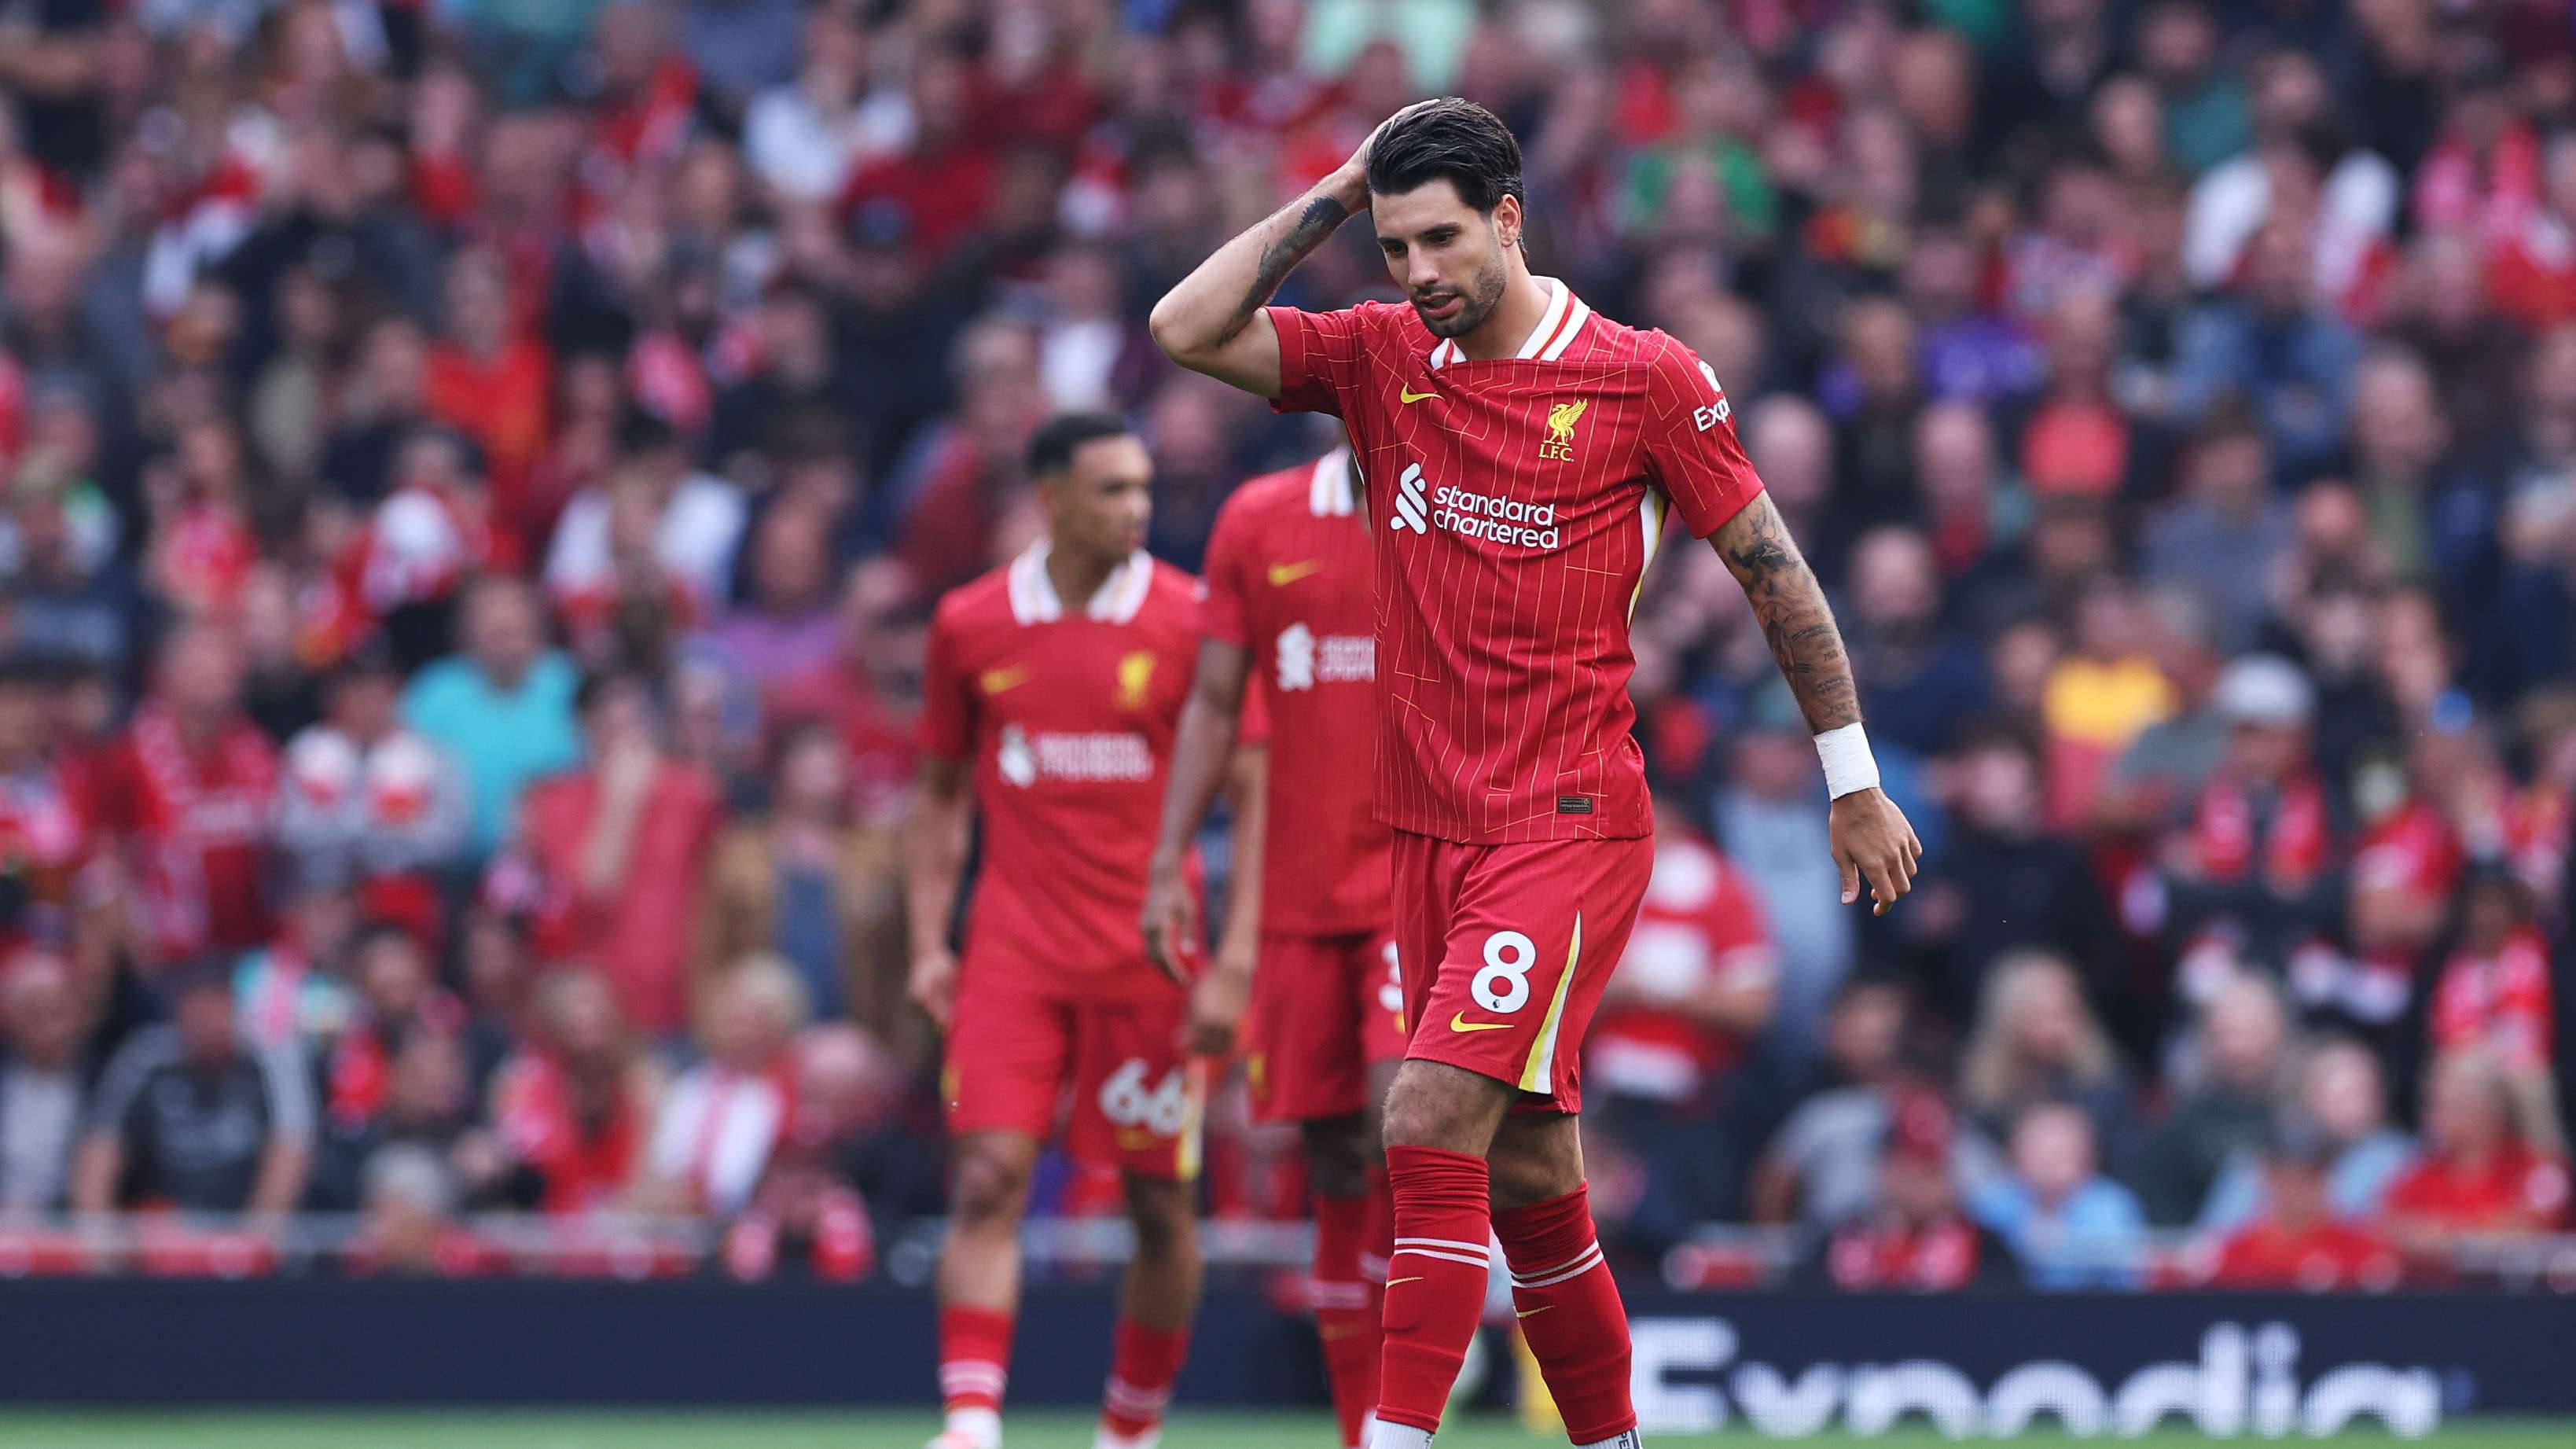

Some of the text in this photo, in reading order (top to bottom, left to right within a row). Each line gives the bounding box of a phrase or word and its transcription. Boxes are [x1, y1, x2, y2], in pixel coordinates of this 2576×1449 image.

[1693, 395, 1730, 432] Exp
[1434, 485, 1554, 526] standard
[1434, 507, 1559, 549] chartered
[1471, 930, 1537, 1013] 8
[1097, 1057, 1184, 1134] 66
